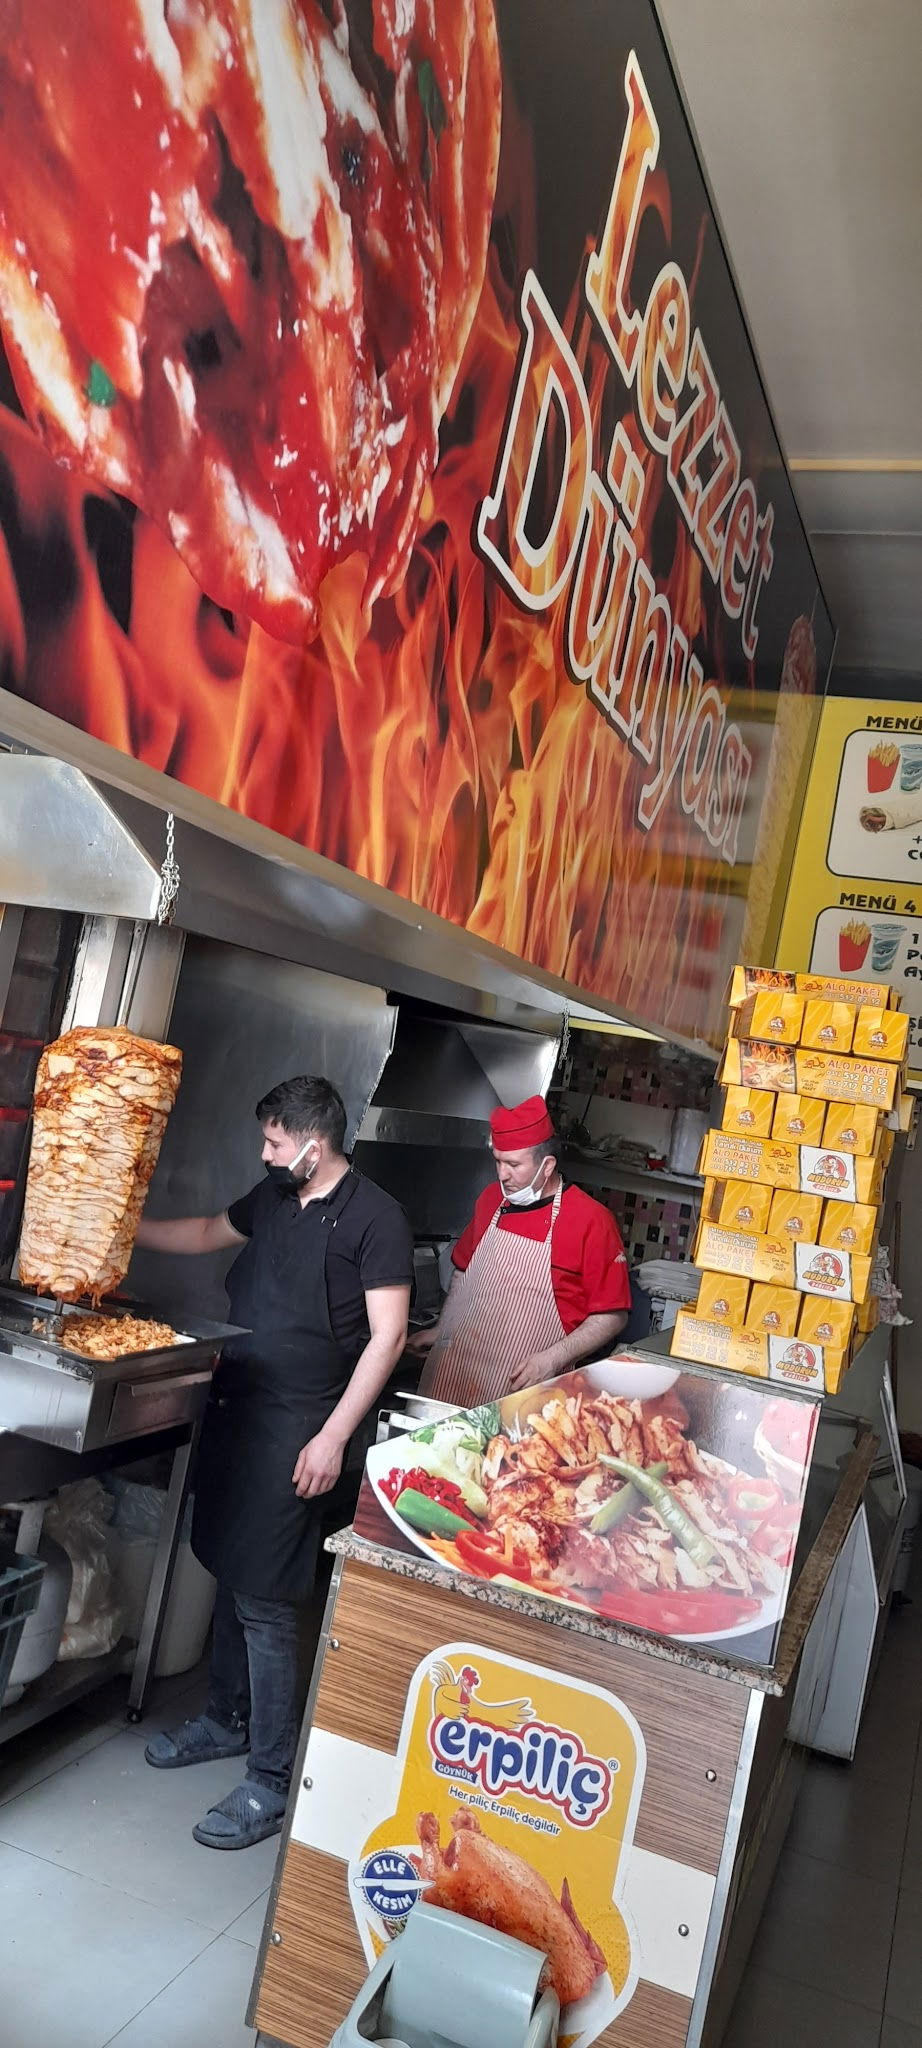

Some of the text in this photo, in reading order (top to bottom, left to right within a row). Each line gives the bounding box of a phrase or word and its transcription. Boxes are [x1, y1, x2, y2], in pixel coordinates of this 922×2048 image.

[586, 48, 773, 662] Lezzet
[478, 270, 752, 865] Dünyası
[839, 892, 916, 913] MENÜ 4
[825, 982, 846, 992] ALO
[849, 985, 881, 997] PAKET
[828, 1060, 890, 1076] ALO PAKET
[713, 1148, 731, 1157] ALO
[733, 1151, 761, 1162] PAKET
[437, 1763, 474, 1782] GÖYNÜK
[439, 1720, 601, 1815] erpiliç
[449, 1785, 561, 1835] Her piliç Erpiliç değildir
[373, 1858, 406, 1876] ELLE
[372, 1889, 413, 1911] KESİM
